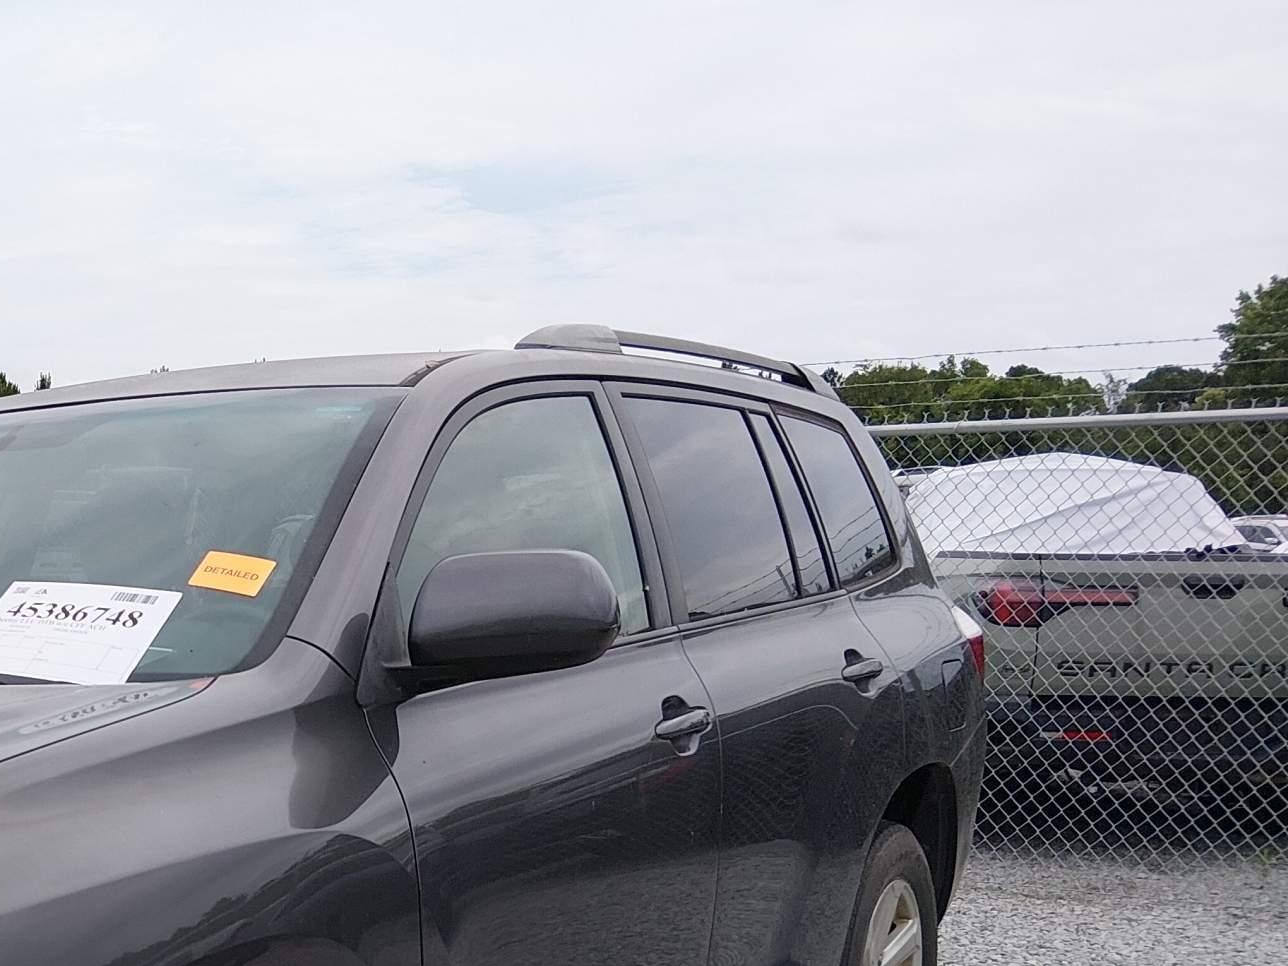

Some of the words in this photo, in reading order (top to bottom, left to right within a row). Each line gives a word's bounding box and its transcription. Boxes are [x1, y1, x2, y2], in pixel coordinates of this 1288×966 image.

[203, 565, 260, 581] DETAILED
[7, 601, 144, 628] 45386748
[1057, 660, 1214, 679] SANTA
